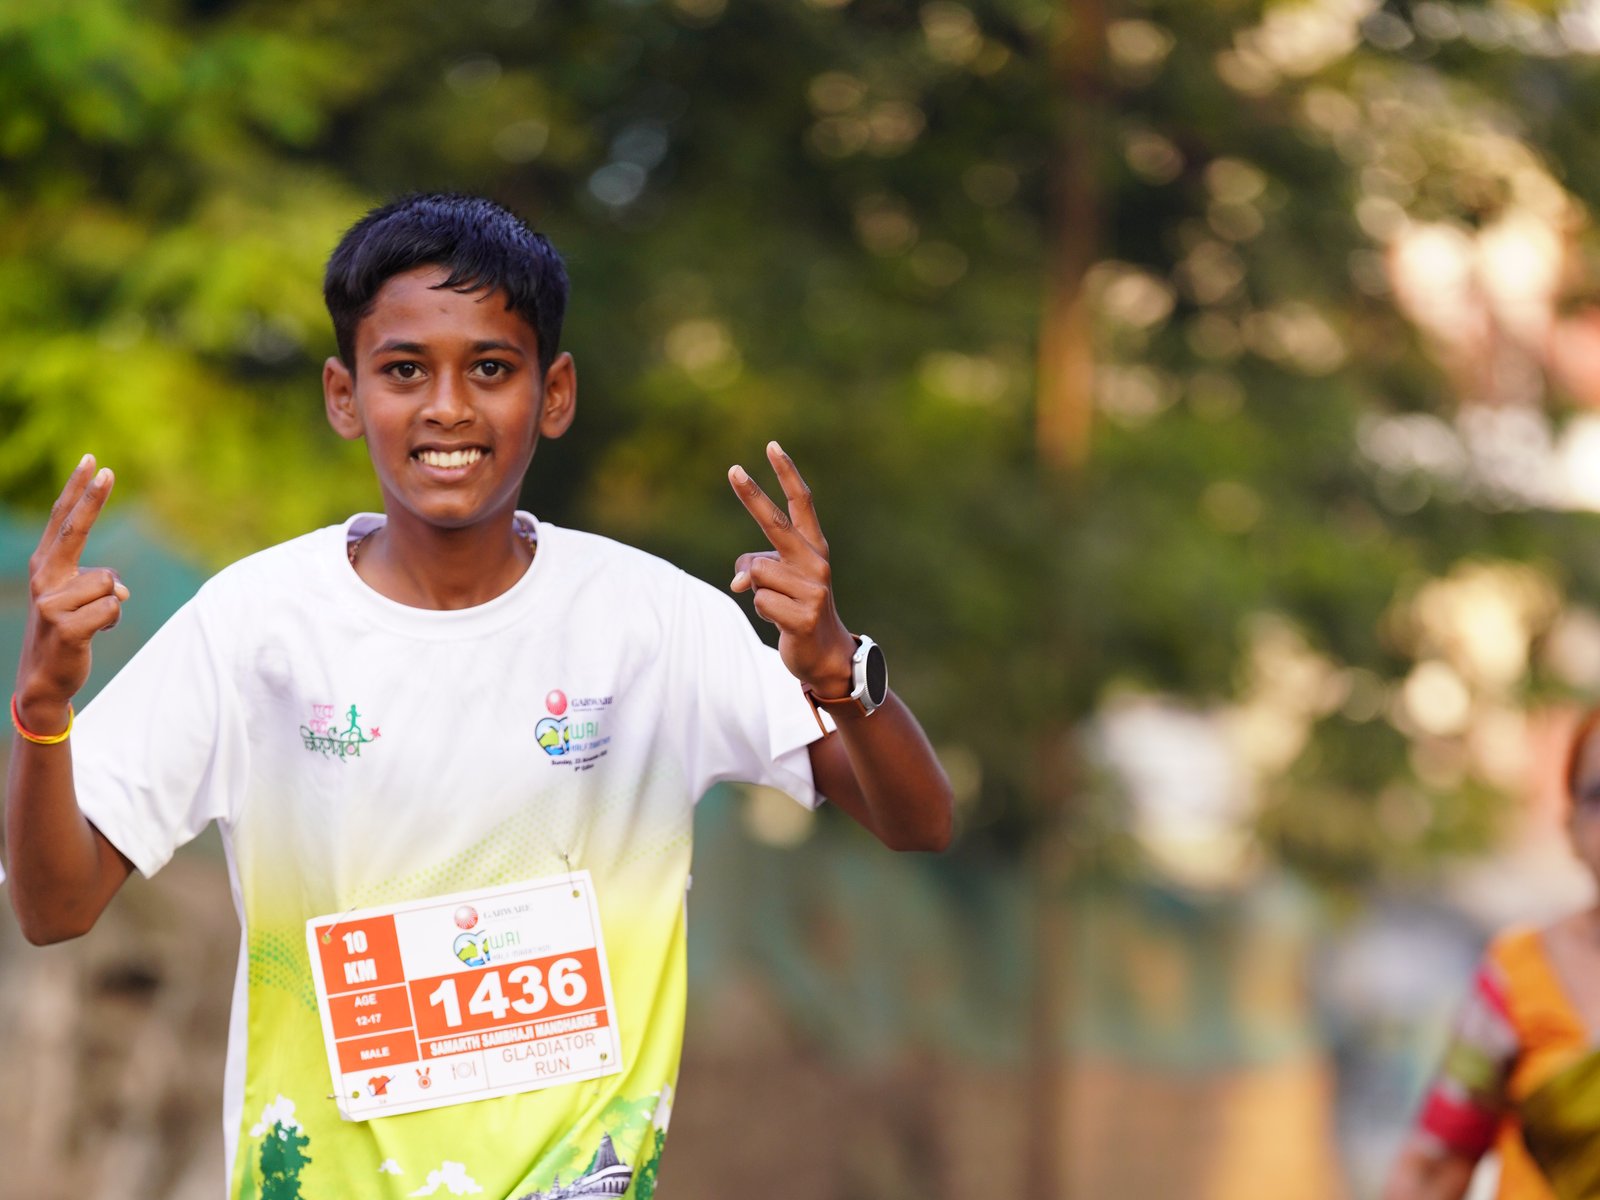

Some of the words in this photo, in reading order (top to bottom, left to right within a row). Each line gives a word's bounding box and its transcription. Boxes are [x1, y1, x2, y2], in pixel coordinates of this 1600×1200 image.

[342, 930, 368, 955] 10
[489, 930, 521, 950] WAI
[343, 958, 378, 984] KM
[354, 993, 377, 1008] AGE
[429, 957, 588, 1028] 1436
[355, 1013, 382, 1026] 12-17
[360, 1046, 390, 1061] MALE
[430, 1034, 481, 1057] SAMARTH
[502, 1032, 596, 1063] GLADIATOR
[535, 1057, 571, 1076] RUN
